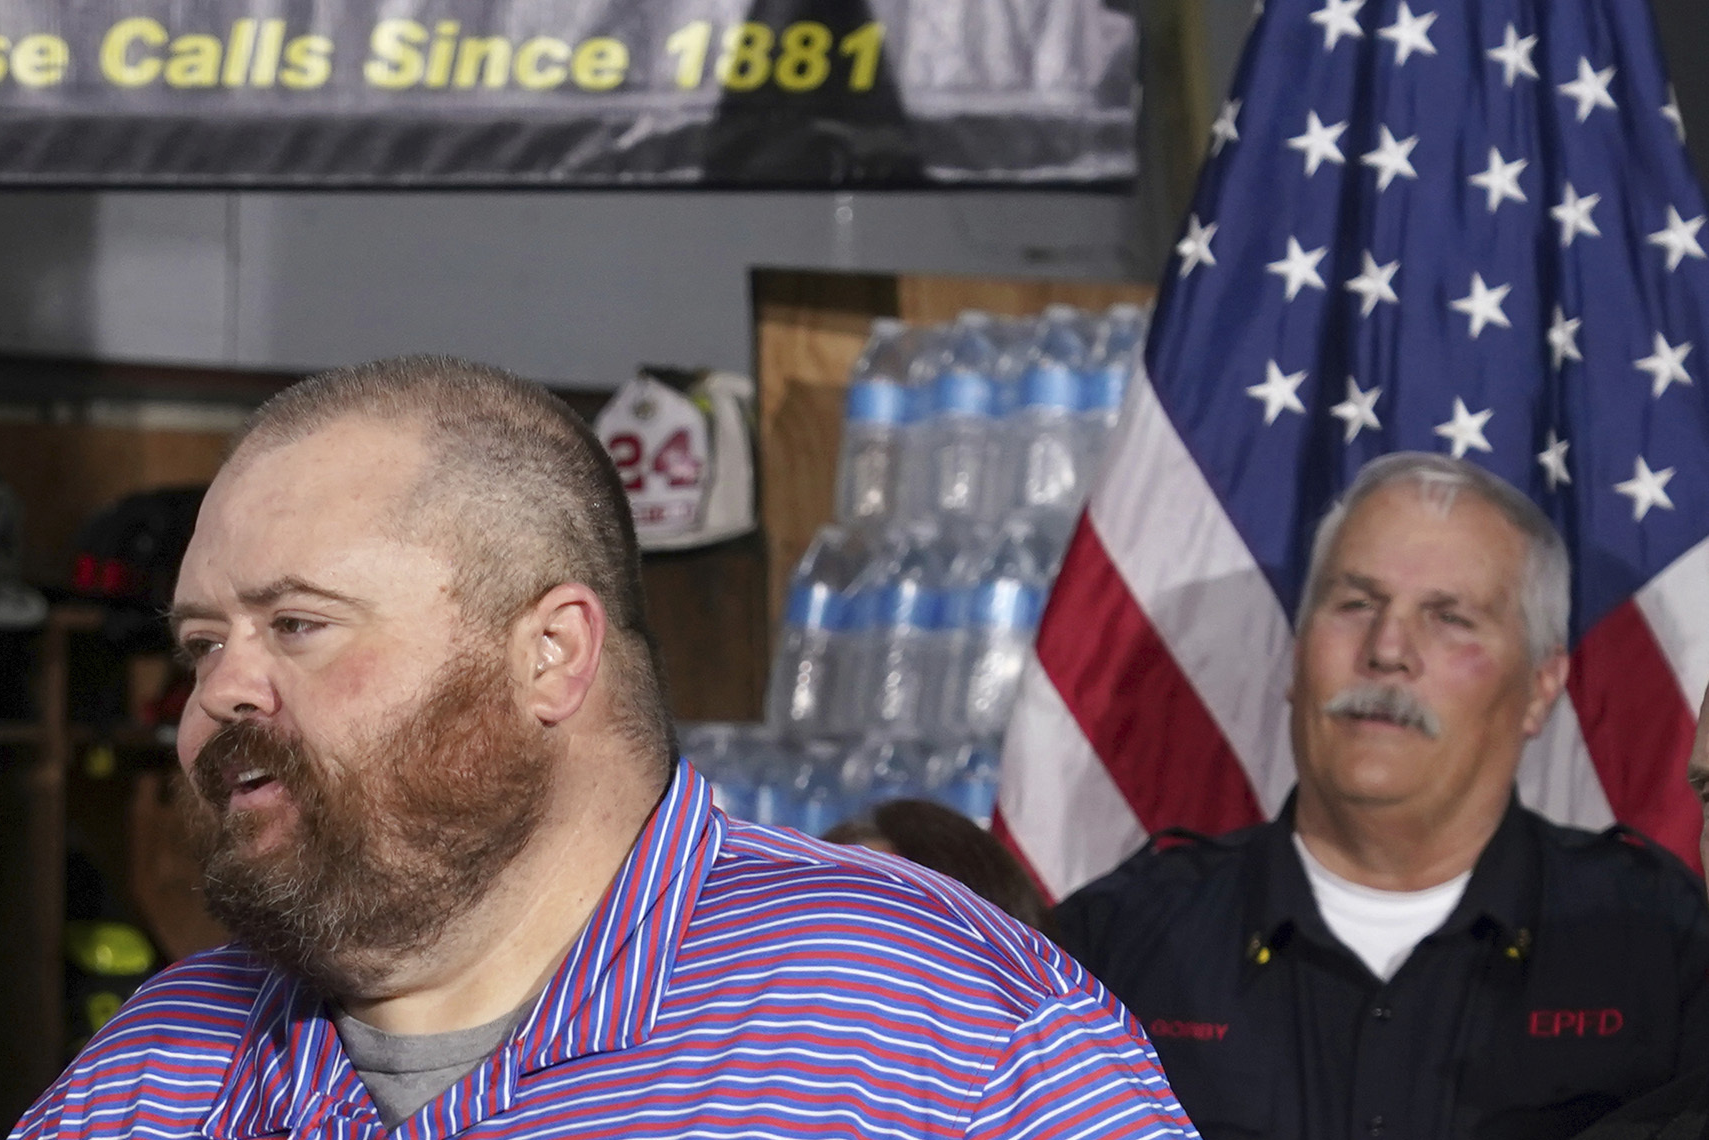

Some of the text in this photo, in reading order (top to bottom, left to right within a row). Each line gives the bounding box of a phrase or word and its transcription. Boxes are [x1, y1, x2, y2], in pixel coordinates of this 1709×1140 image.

[100, 18, 331, 89] Calls
[364, 21, 628, 90] Since
[665, 21, 883, 92] 1881
[608, 429, 701, 489] 24
[1528, 1008, 1624, 1038] EPFD
